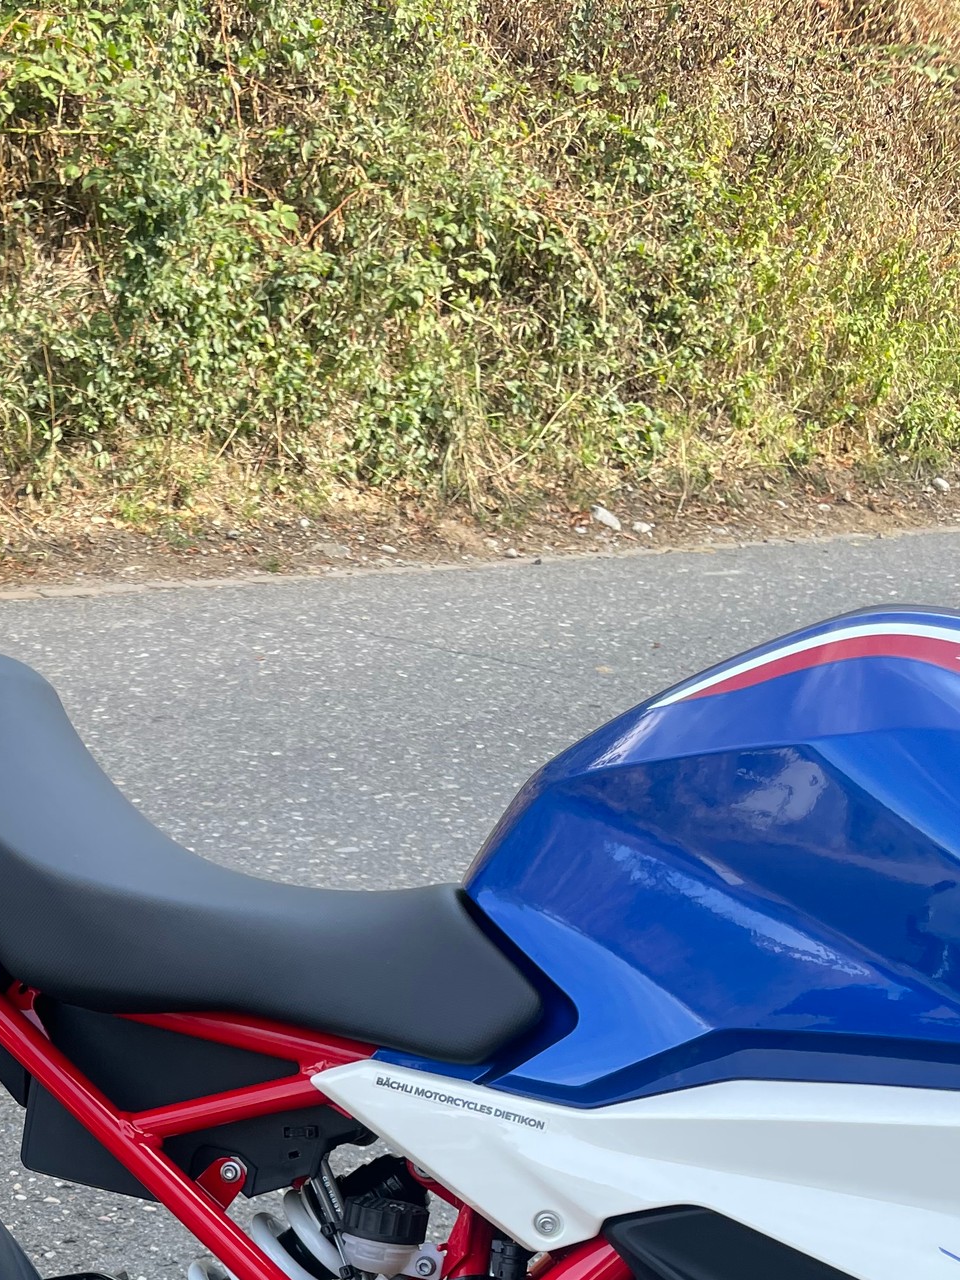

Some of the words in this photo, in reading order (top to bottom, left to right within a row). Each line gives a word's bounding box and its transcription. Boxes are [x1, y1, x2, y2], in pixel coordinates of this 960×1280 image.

[376, 1076, 413, 1094] BÄCHLI
[414, 1086, 493, 1115] MOTORCYCLES
[494, 1108, 546, 1130] DIETIKON
